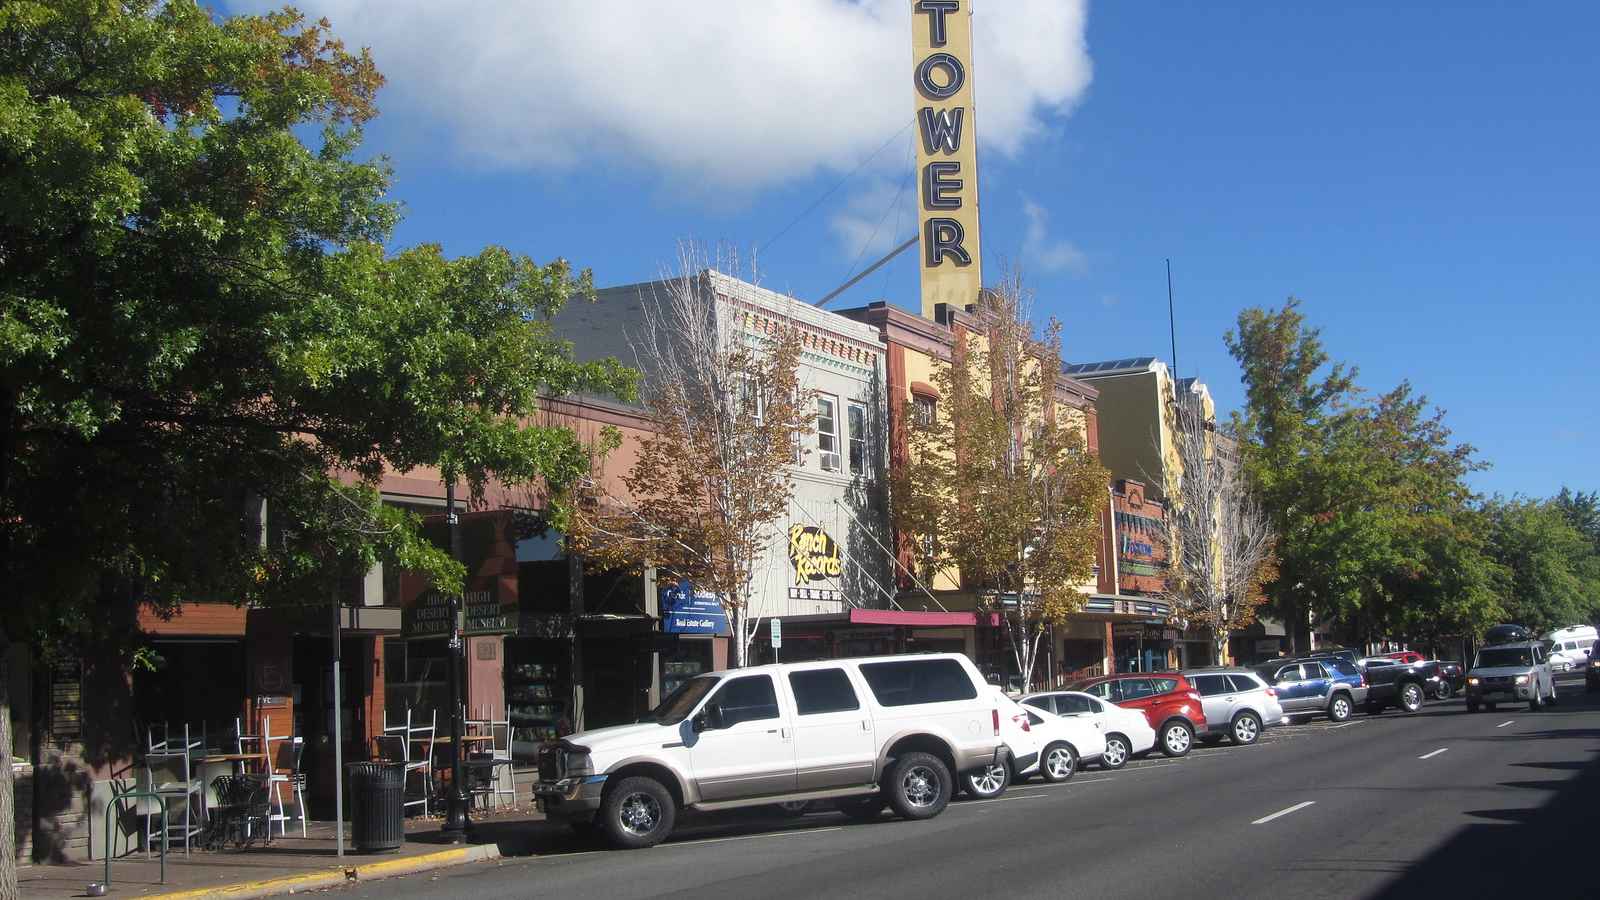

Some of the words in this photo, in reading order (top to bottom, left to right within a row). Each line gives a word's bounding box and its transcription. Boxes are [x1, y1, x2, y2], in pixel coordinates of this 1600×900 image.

[914, 0, 972, 267] TOWER
[788, 523, 827, 557] Ranch
[790, 543, 841, 585] Records
